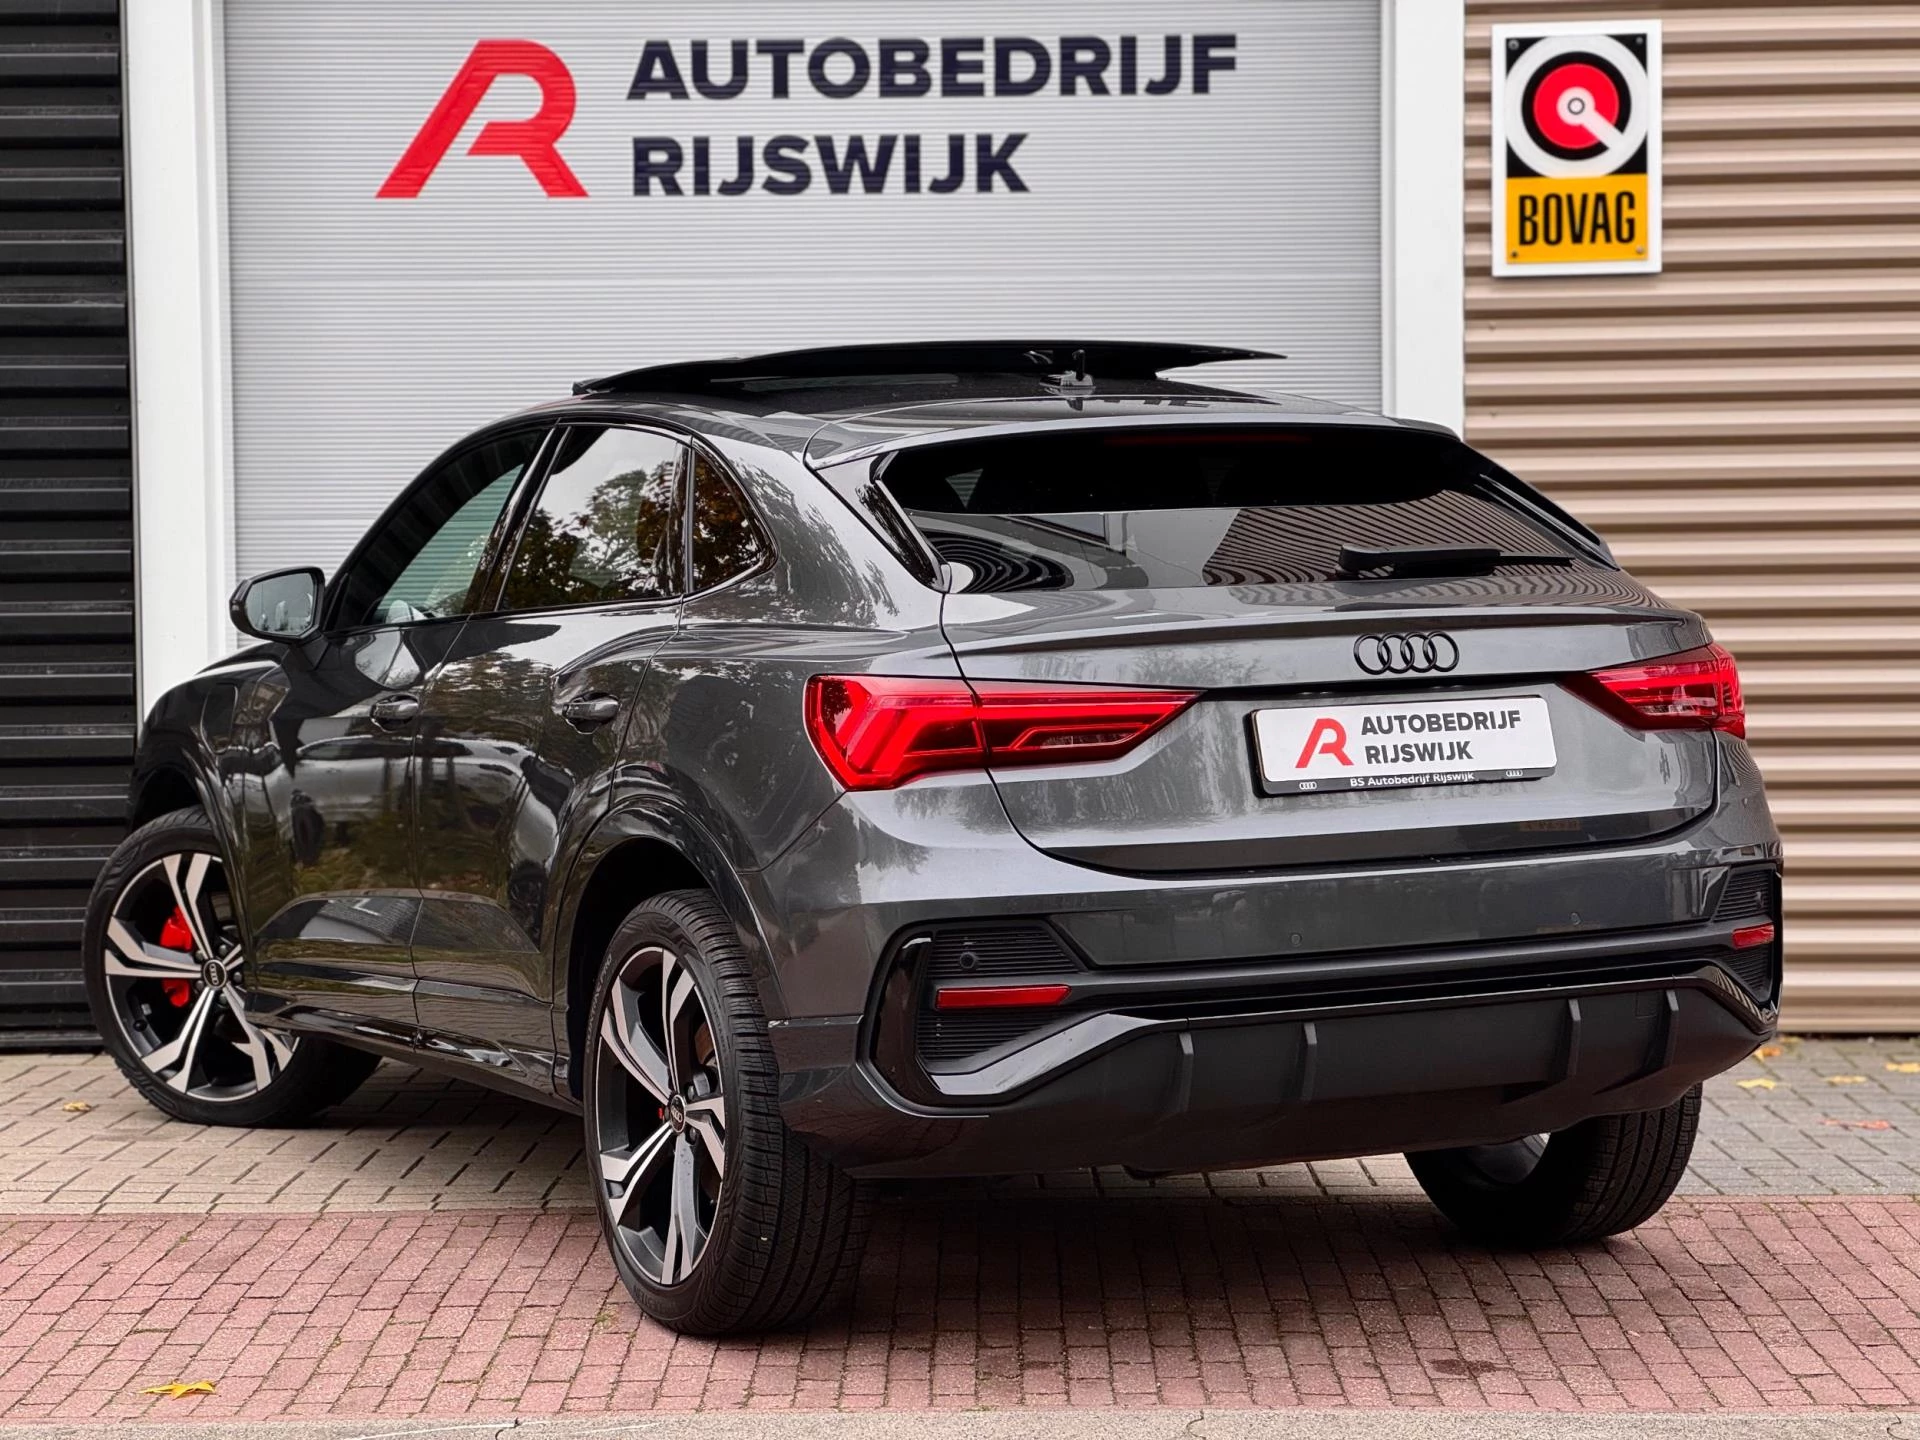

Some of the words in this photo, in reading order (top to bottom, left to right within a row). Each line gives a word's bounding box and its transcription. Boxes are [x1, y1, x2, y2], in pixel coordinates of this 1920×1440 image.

[628, 34, 1237, 100] AUTOBEDRIJF
[633, 133, 1029, 196] RIJSWIJK
[1519, 191, 1635, 246] BOVAG
[1361, 710, 1521, 735] AUTOBEDRIJF
[1365, 741, 1473, 765] RIJSWIJK
[1350, 777, 1365, 787] BS
[1367, 774, 1431, 787] Autobedrijf
[1432, 772, 1475, 784] Rijswijk
